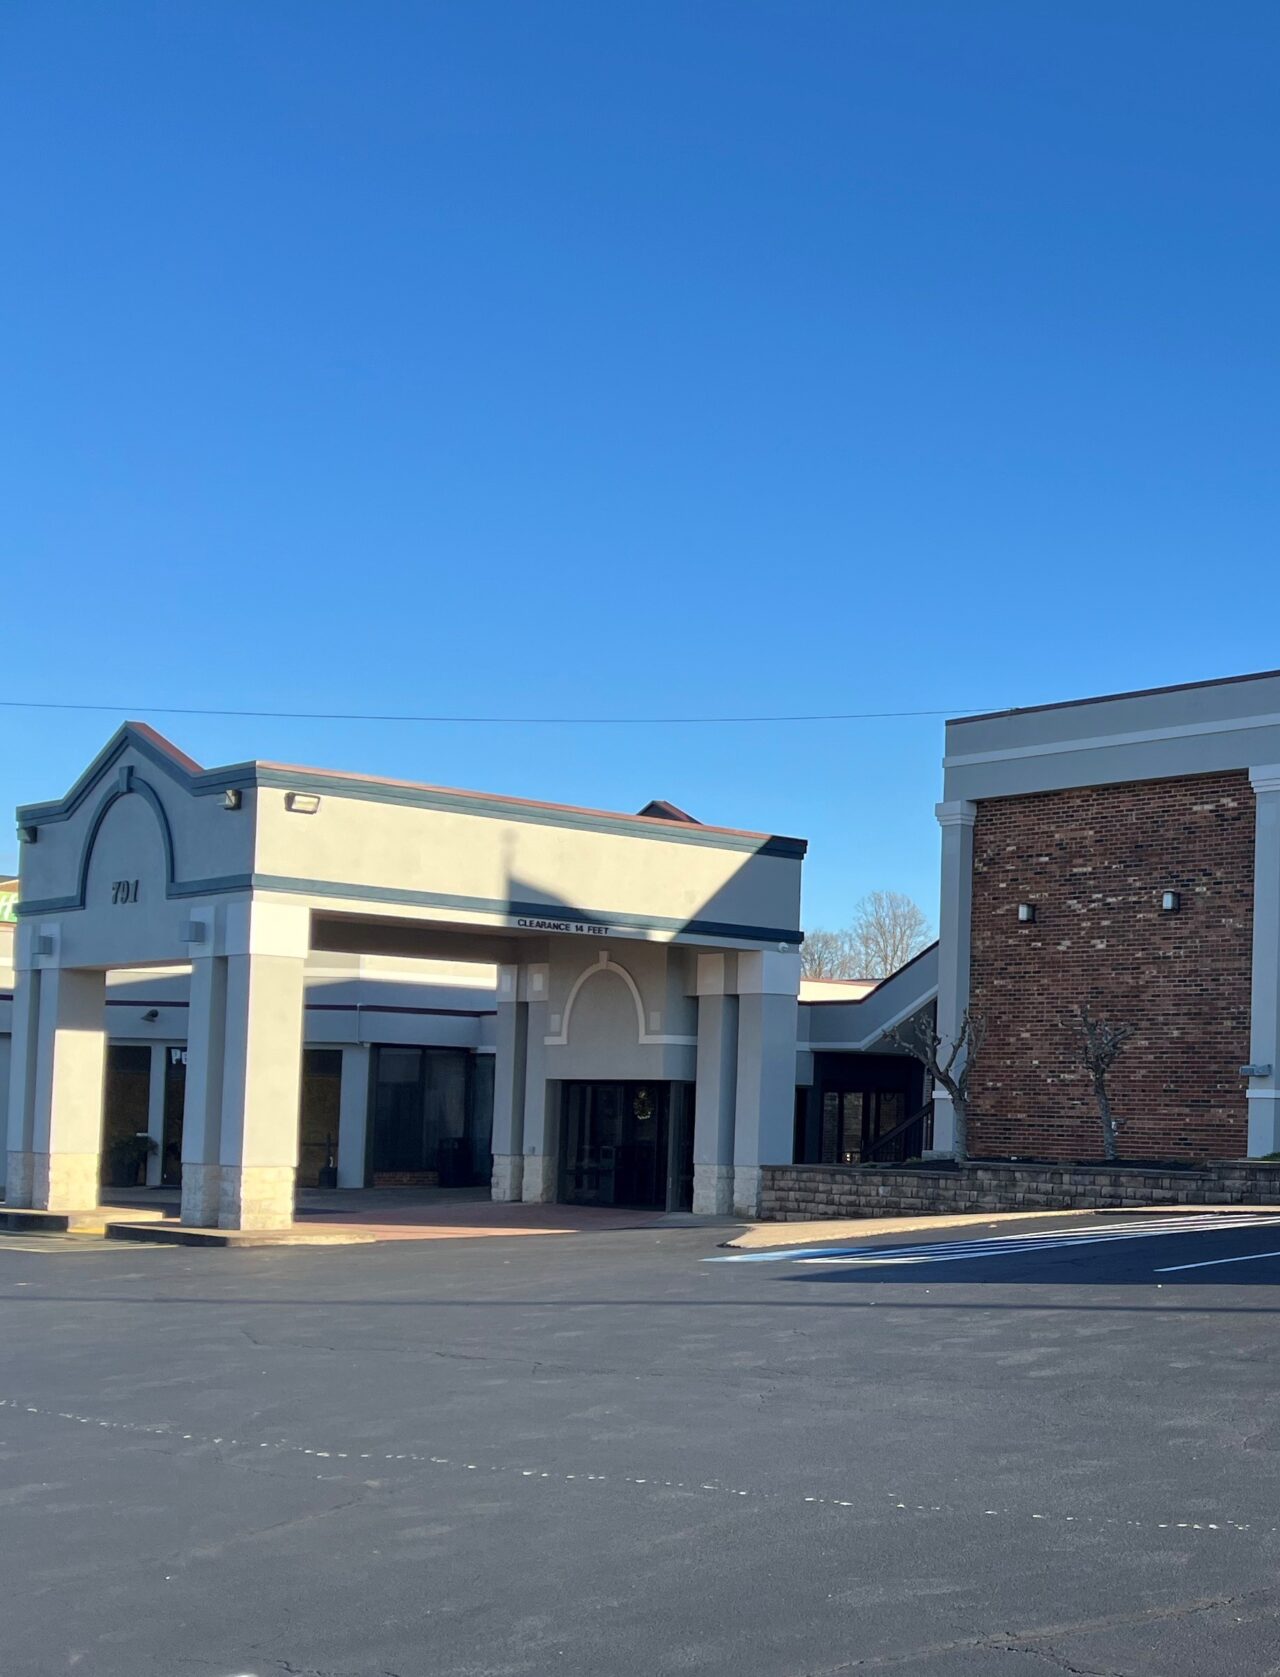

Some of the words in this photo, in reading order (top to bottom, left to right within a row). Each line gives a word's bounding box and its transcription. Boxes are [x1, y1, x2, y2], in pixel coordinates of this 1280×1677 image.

[112, 879, 139, 905] 791
[517, 918, 571, 931] CLEARANCE
[575, 924, 584, 932] 14
[587, 925, 609, 935] FEET
